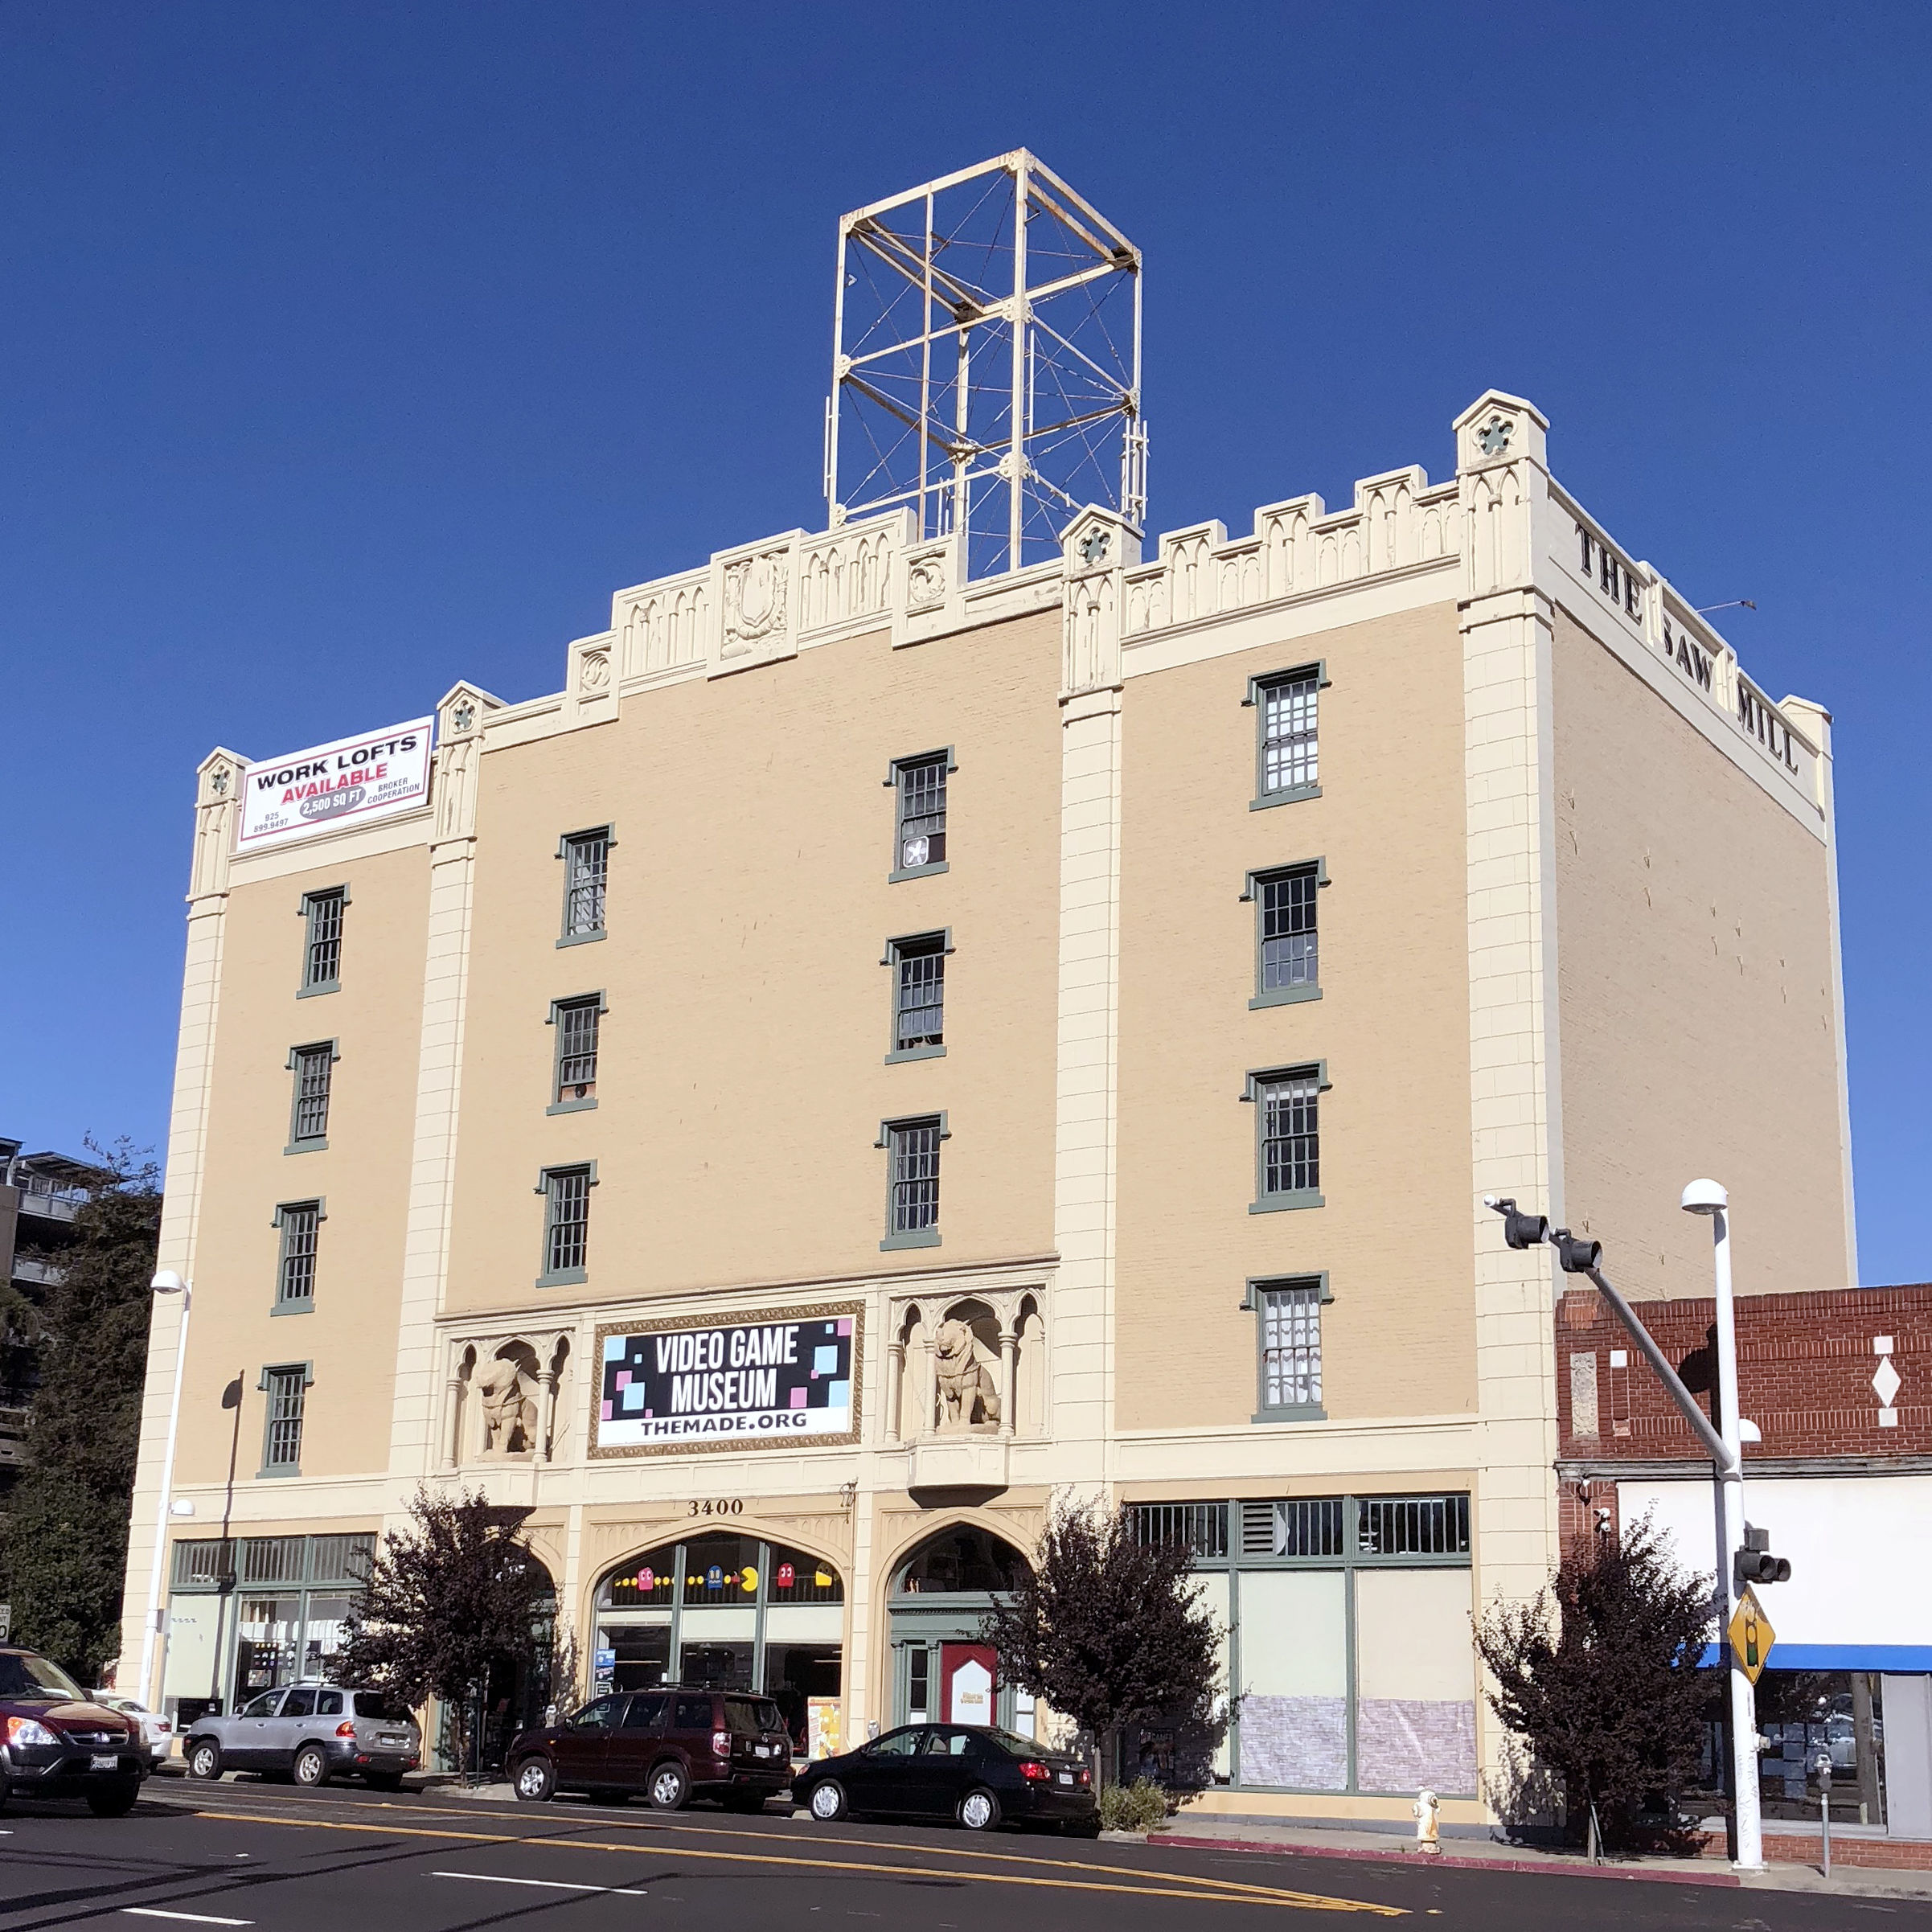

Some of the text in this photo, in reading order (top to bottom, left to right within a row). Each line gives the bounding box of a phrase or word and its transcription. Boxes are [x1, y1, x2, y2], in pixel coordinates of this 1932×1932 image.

[1575, 523, 1799, 776] THE SAW MILL
[257, 736, 416, 790] WORK LOFTS
[282, 763, 388, 804] AVAILABLE
[367, 783, 420, 804] COOPERATION
[378, 777, 408, 792] BROKER
[302, 788, 363, 815] 2,500 SQ FT
[656, 1326, 800, 1373] VIDEO GAME
[671, 1368, 777, 1413] MUSEUM
[641, 1413, 807, 1436] THEMADE.ORG
[687, 1499, 744, 1517] 3400
